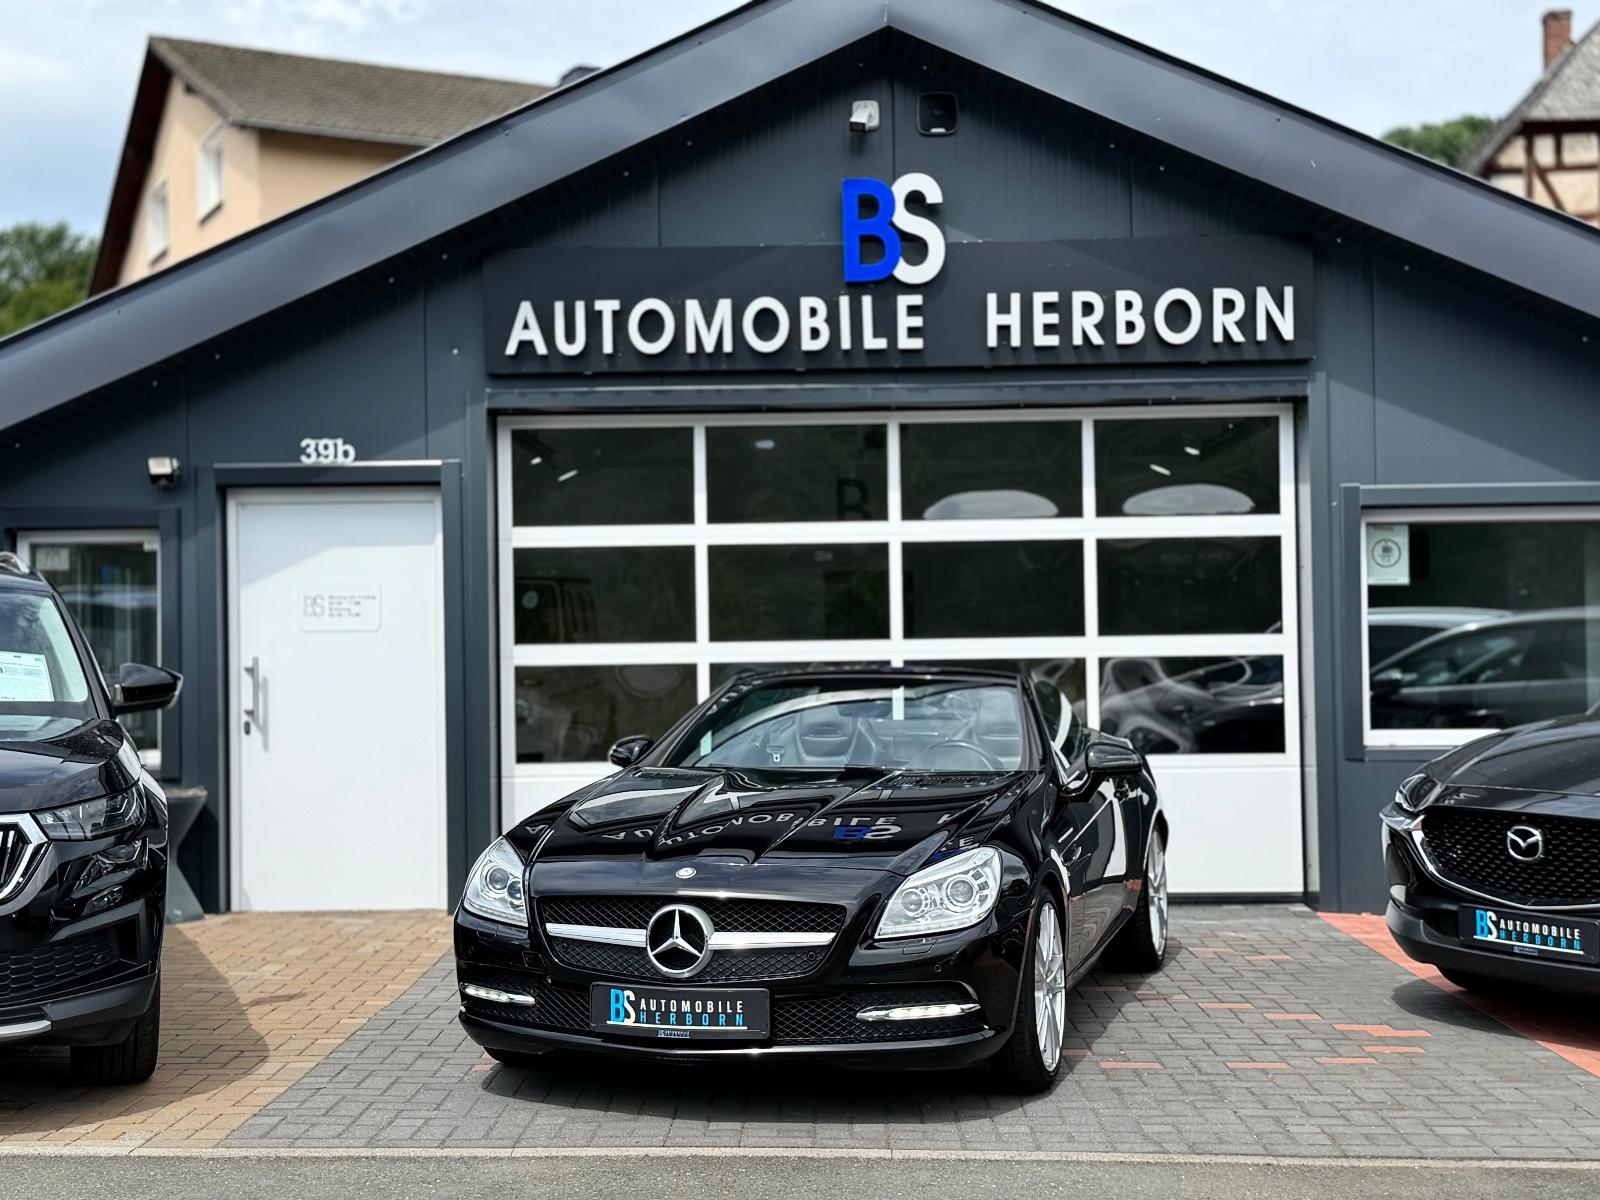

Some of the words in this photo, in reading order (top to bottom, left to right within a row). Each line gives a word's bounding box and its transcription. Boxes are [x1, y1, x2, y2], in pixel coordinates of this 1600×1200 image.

[842, 172, 947, 284] BS
[504, 294, 925, 356] AUTOMOBILE
[986, 286, 1294, 347] HERBORN
[300, 437, 356, 466] 39b
[1475, 909, 1498, 940] BS
[1500, 918, 1581, 939] AUTOMOBILE
[1500, 930, 1581, 950] HERBORN
[610, 988, 636, 1024] BS
[640, 998, 743, 1013] AUTOMOBILE
[640, 1012, 744, 1026] HERBORN
